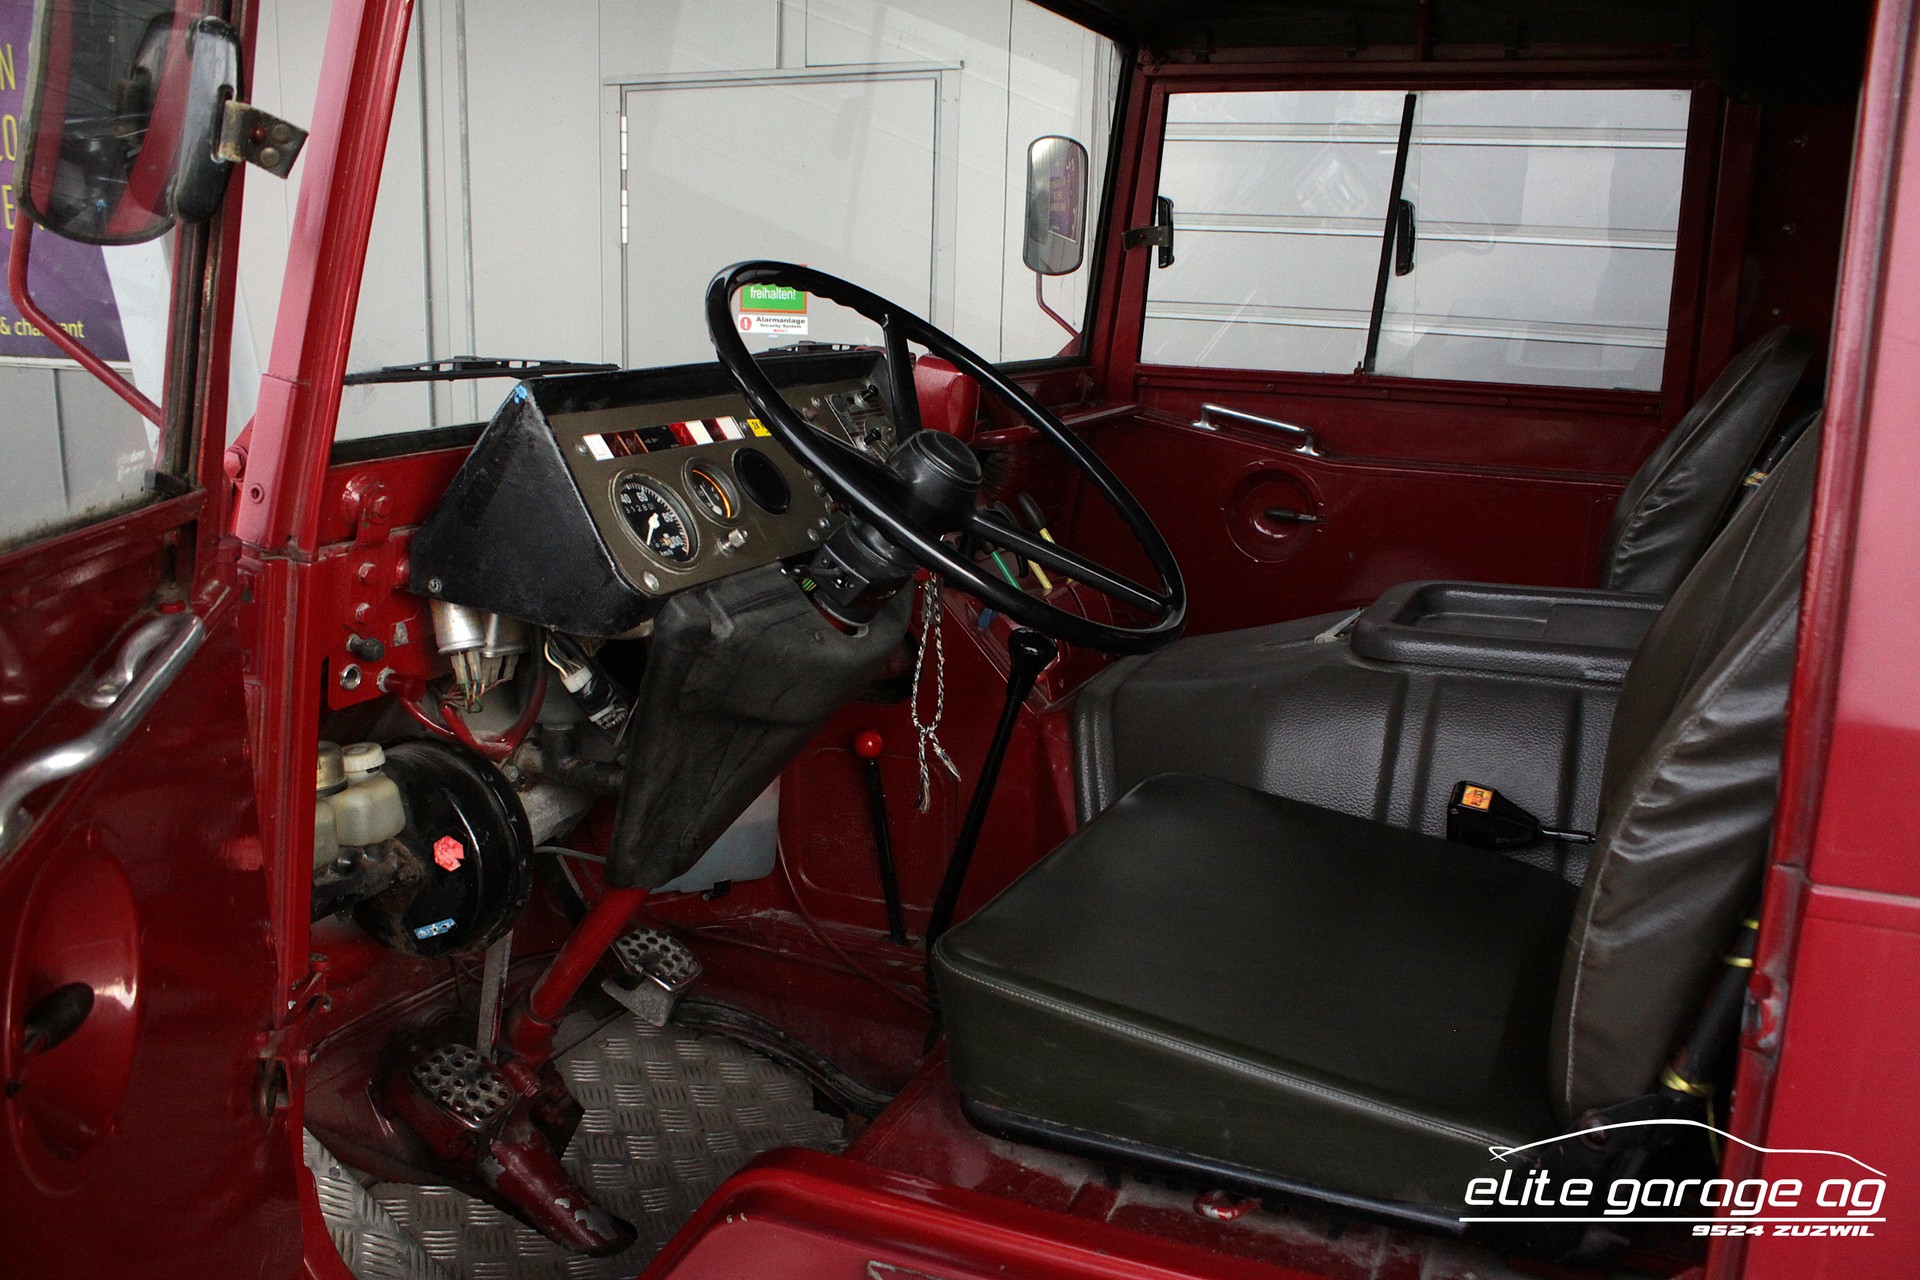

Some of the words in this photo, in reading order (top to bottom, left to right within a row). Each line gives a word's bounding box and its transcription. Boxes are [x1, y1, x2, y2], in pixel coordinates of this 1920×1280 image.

[750, 286, 796, 300] freihalten!
[0, 316, 11, 335] &
[14, 317, 85, 338] chaant
[755, 316, 806, 325] Alarmanlage
